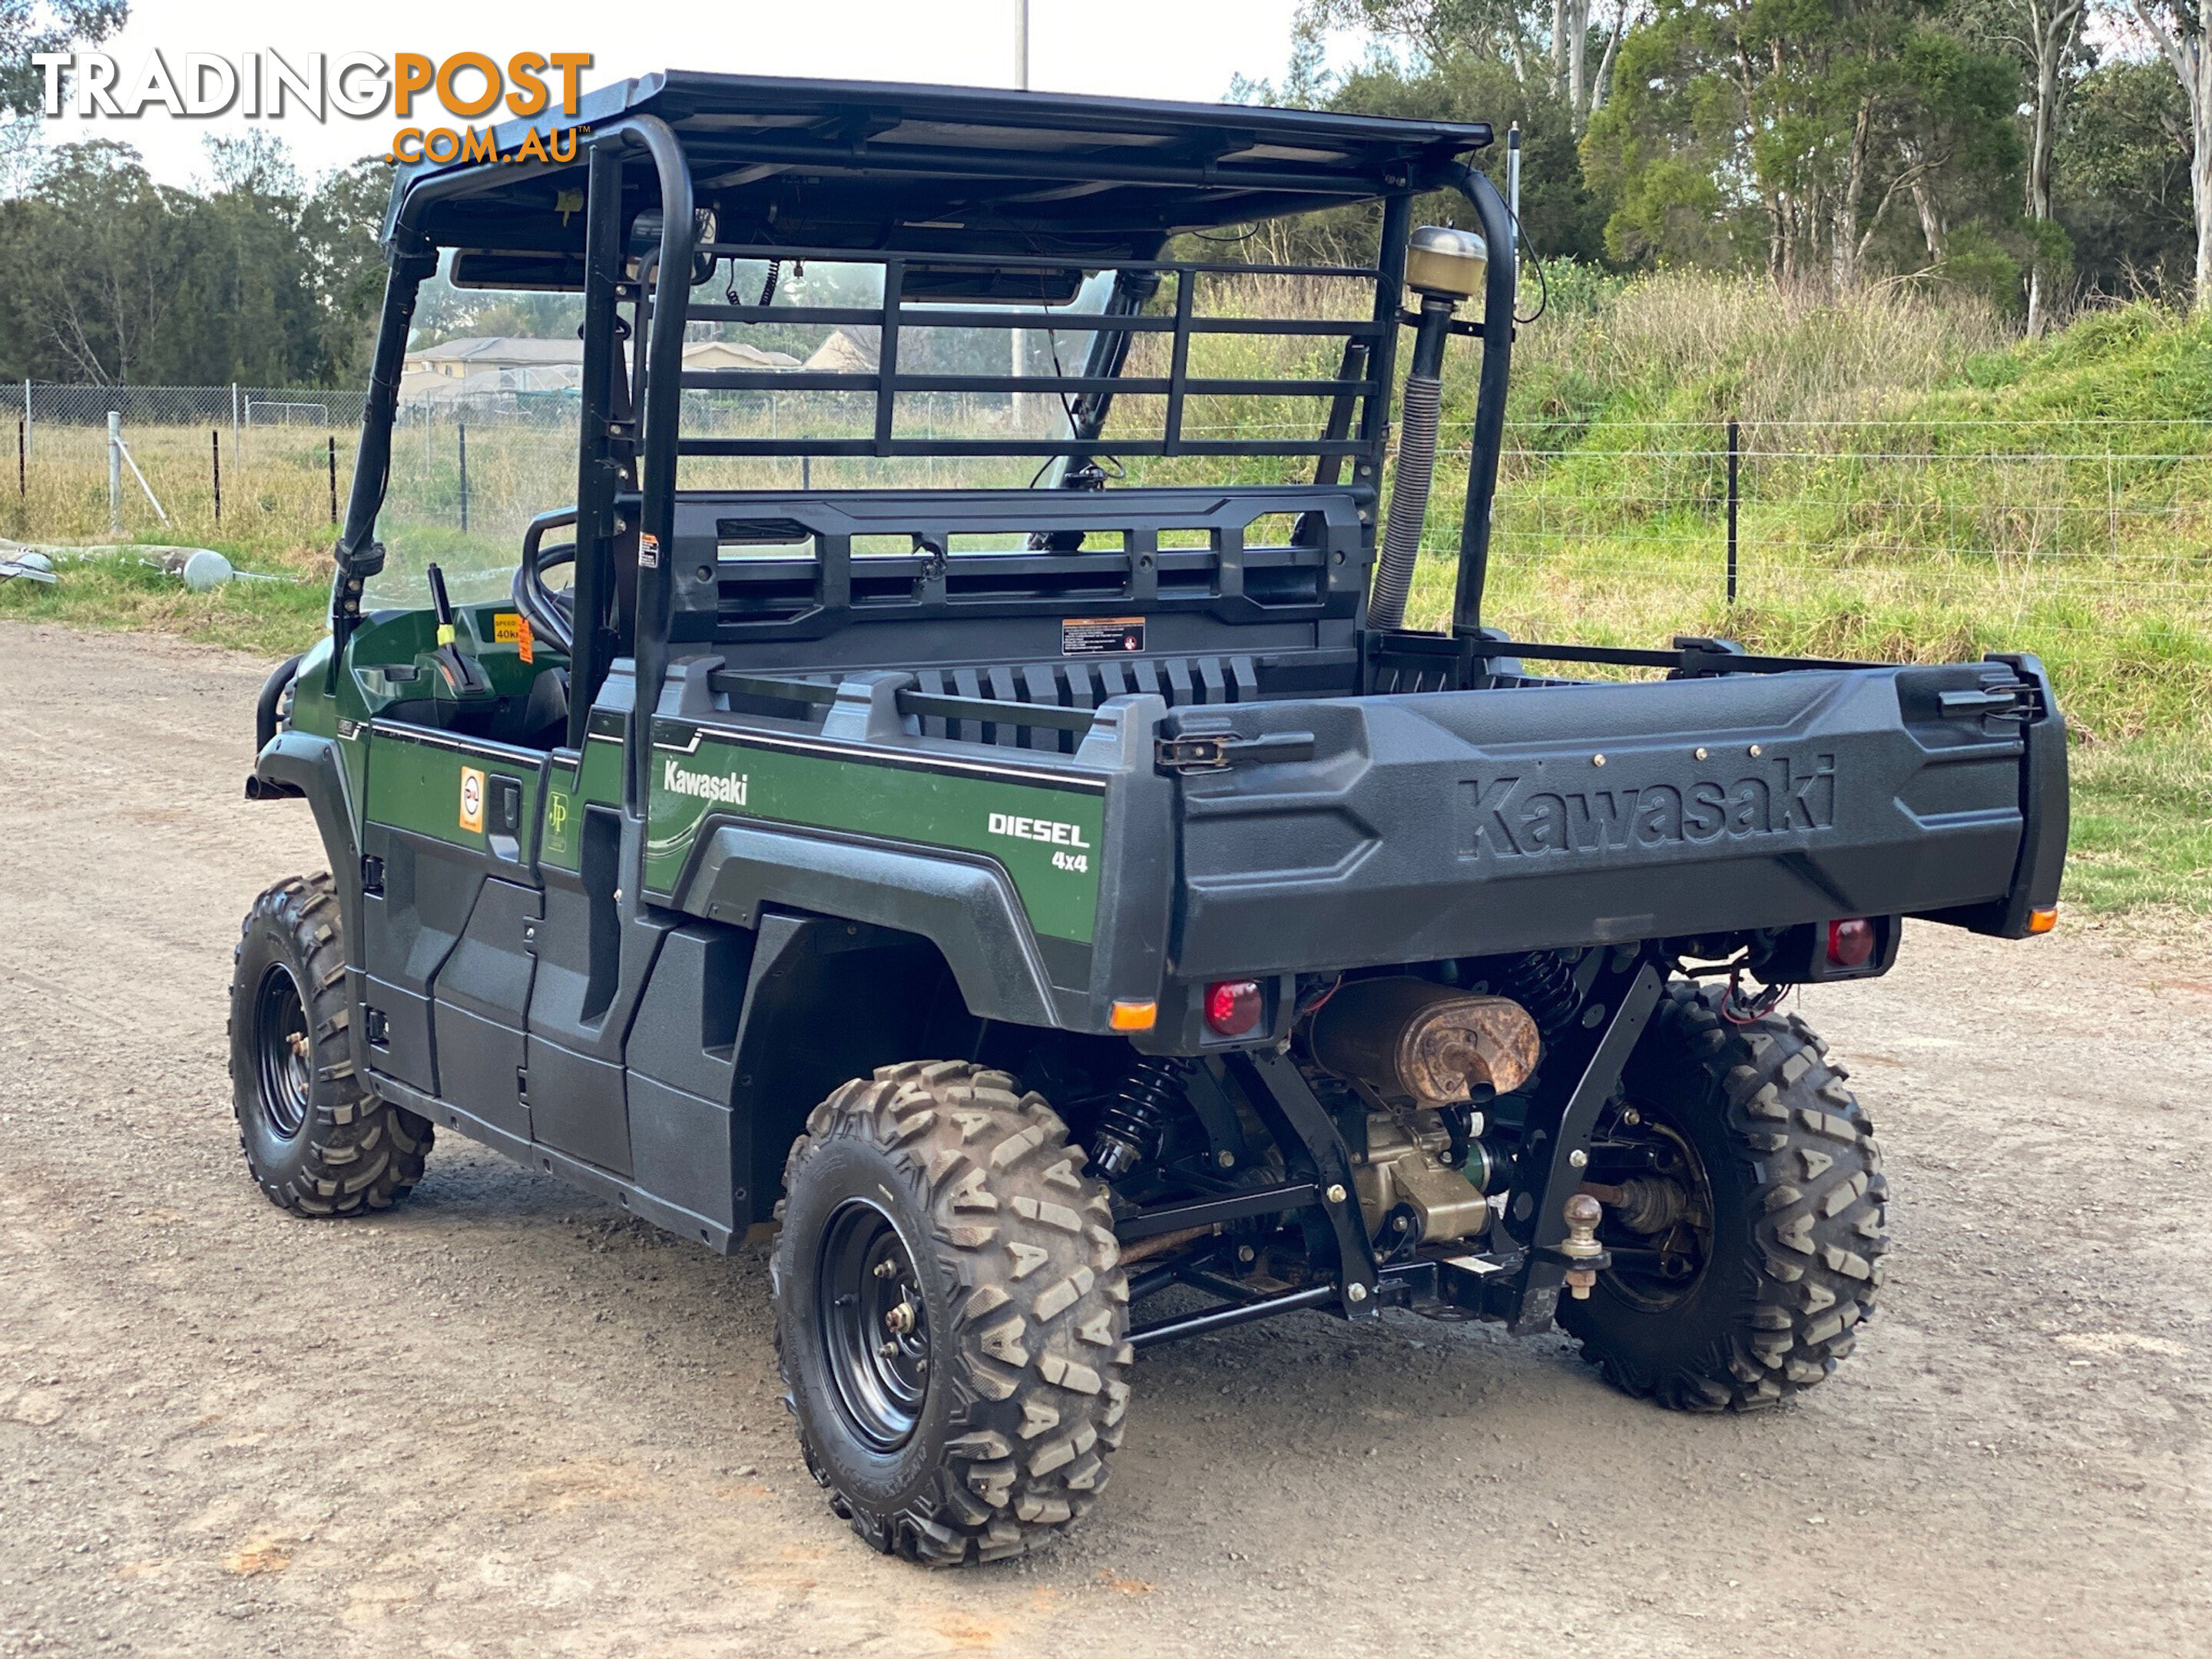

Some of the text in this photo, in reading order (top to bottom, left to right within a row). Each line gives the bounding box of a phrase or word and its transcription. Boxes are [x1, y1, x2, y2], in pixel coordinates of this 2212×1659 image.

[664, 760, 748, 806] Kawasaki
[1456, 753, 1836, 862] Kawasaki
[988, 813, 1090, 848] DIESEL
[1051, 851, 1088, 873] 4x4
